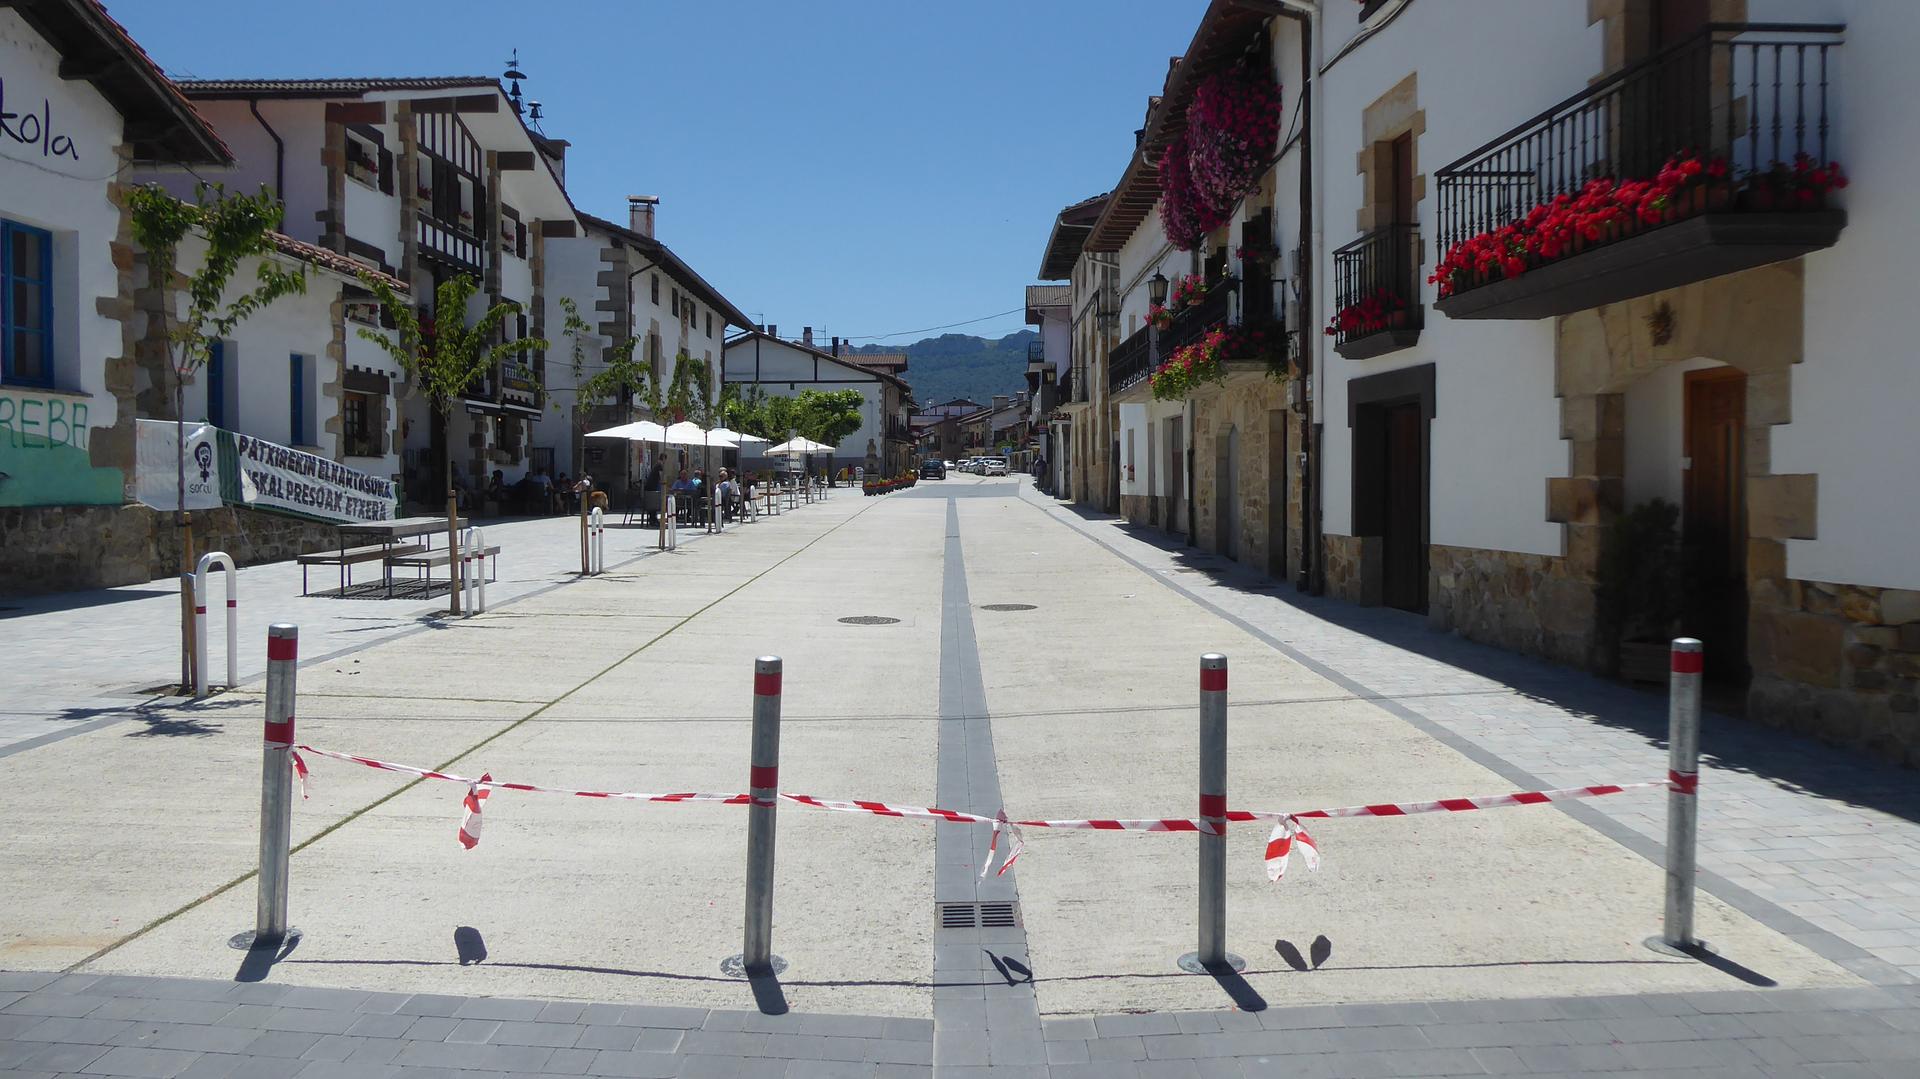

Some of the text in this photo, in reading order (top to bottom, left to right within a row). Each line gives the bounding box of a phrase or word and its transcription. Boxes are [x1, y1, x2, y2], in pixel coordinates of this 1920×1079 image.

[239, 435, 393, 499] PATXIREKIN ELKARTASUNA
[286, 480, 343, 512] PRESOAK
